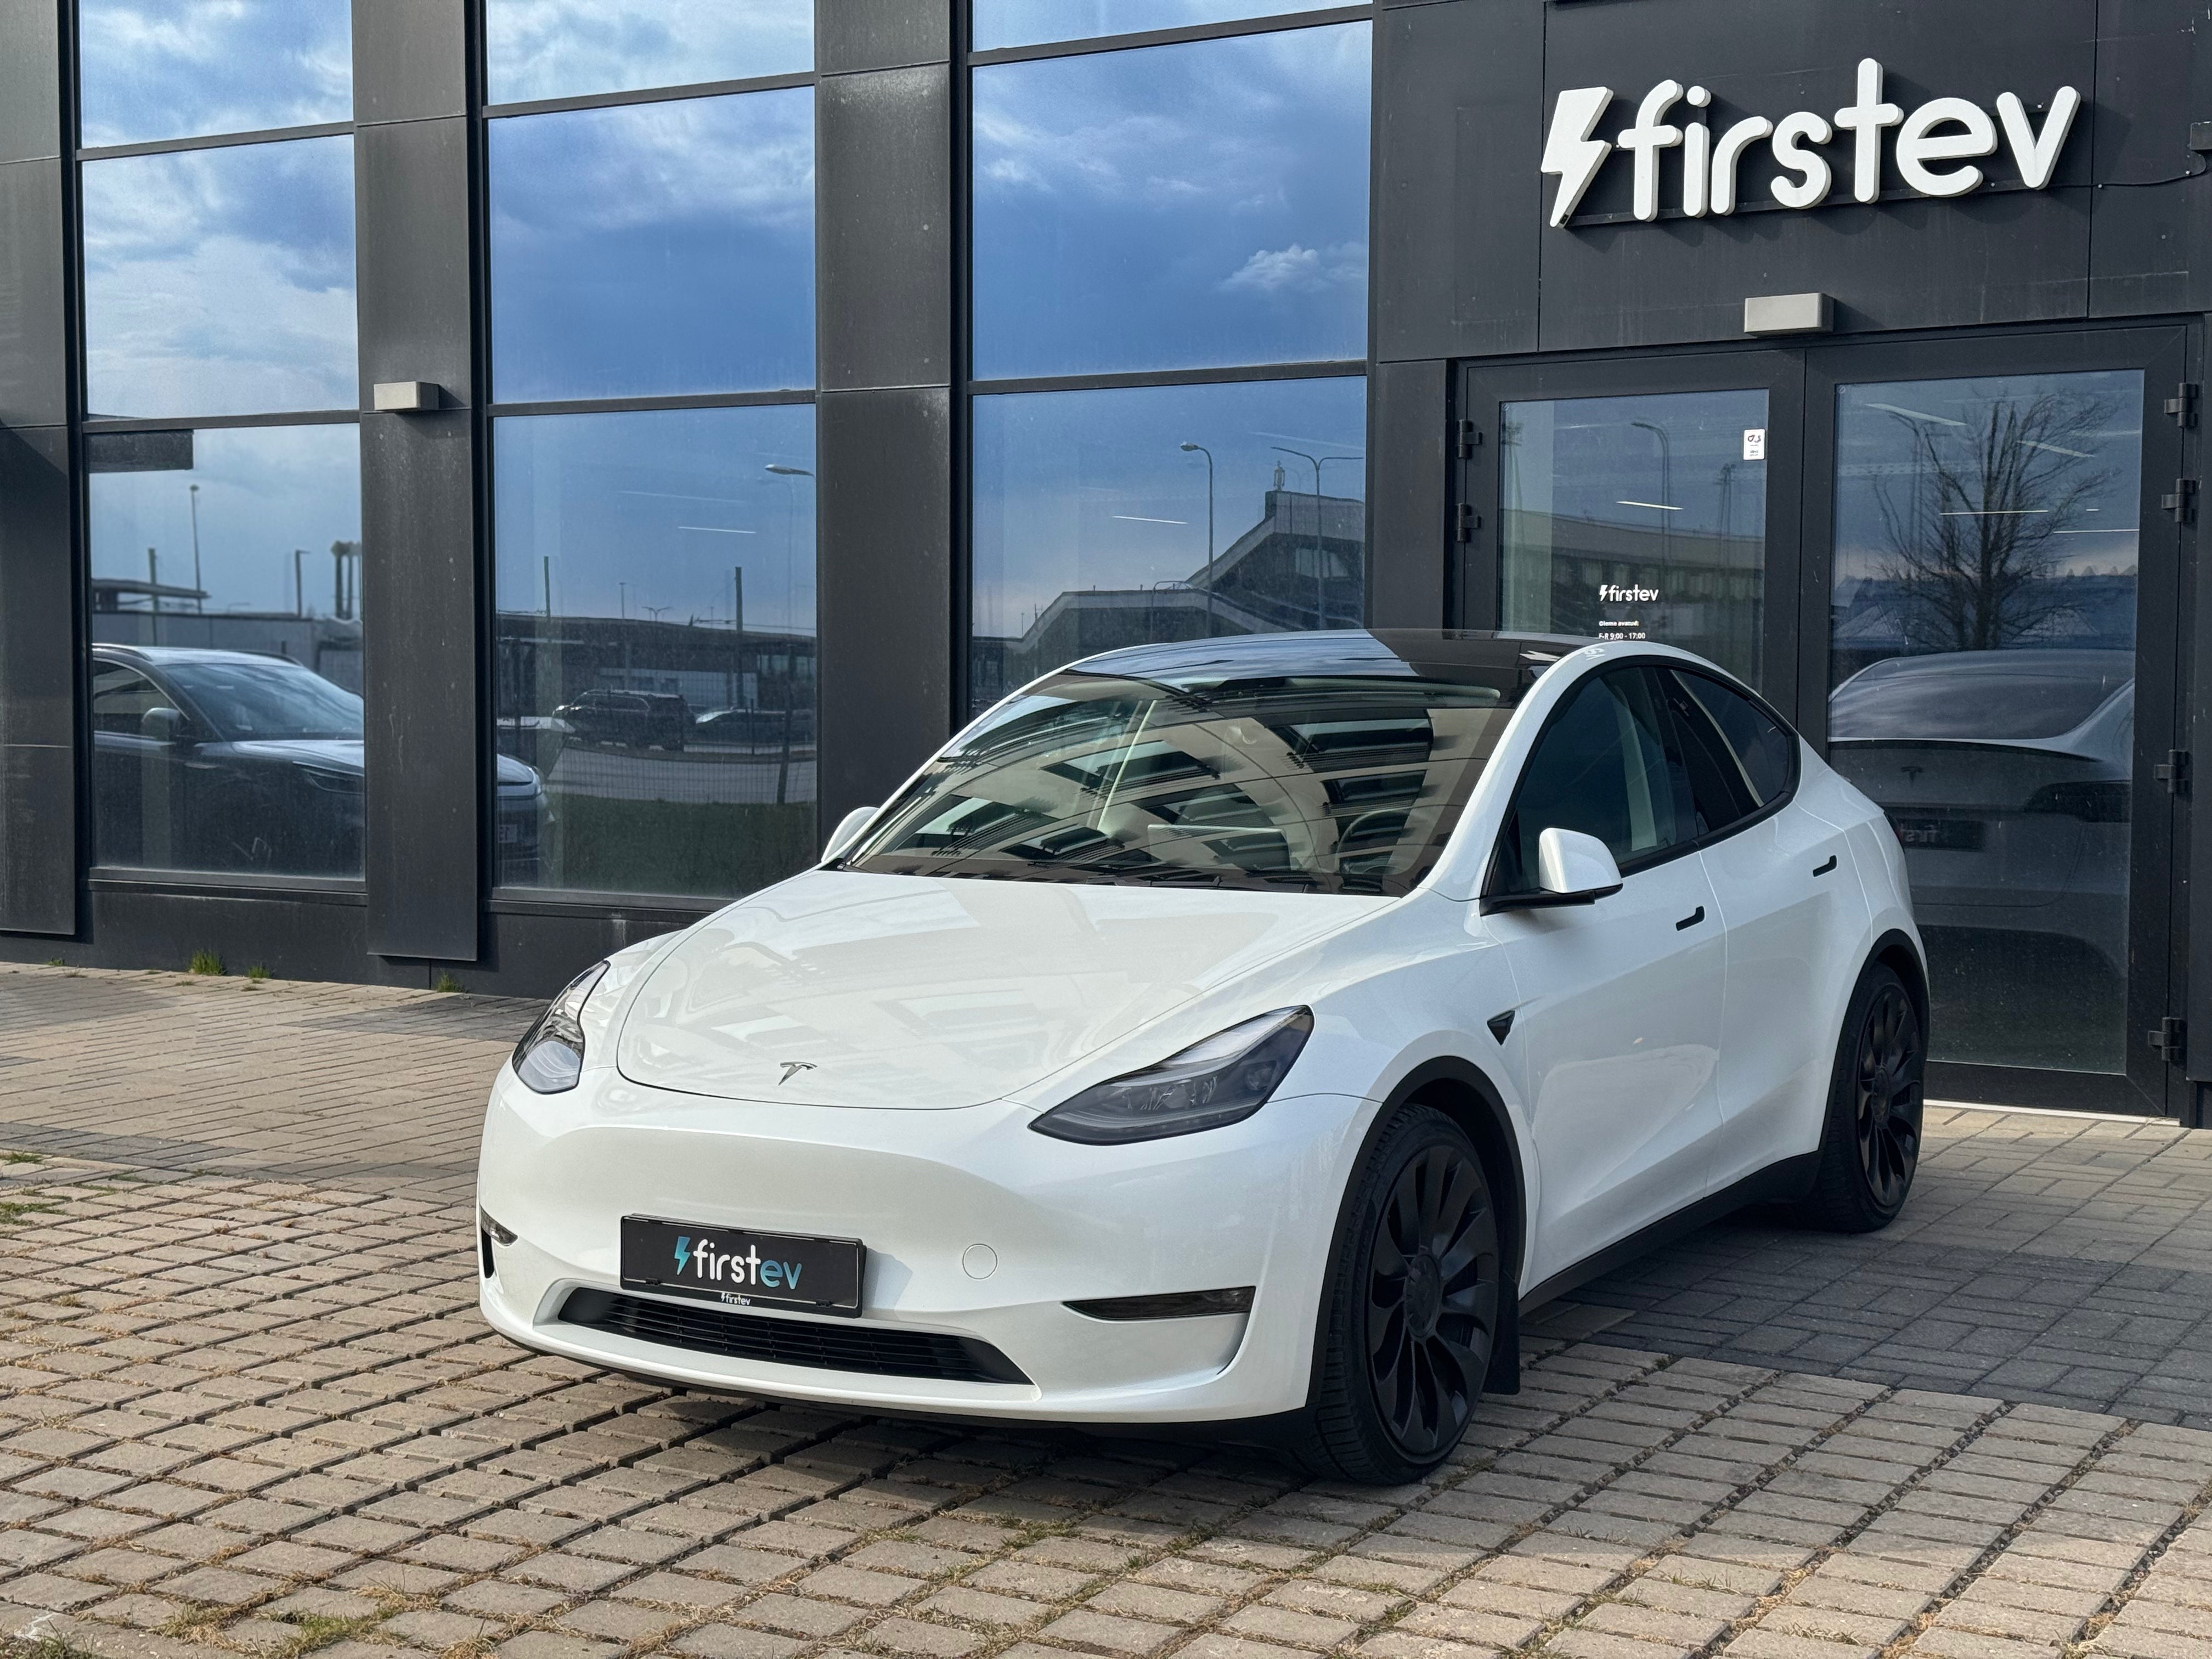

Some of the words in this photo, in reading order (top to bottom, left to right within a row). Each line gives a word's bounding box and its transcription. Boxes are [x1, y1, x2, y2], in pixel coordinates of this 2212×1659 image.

[1618, 58, 2080, 221] firstev
[1609, 584, 1659, 601] firstev
[693, 1239, 802, 1290] firstev
[726, 1294, 751, 1306] firstev
